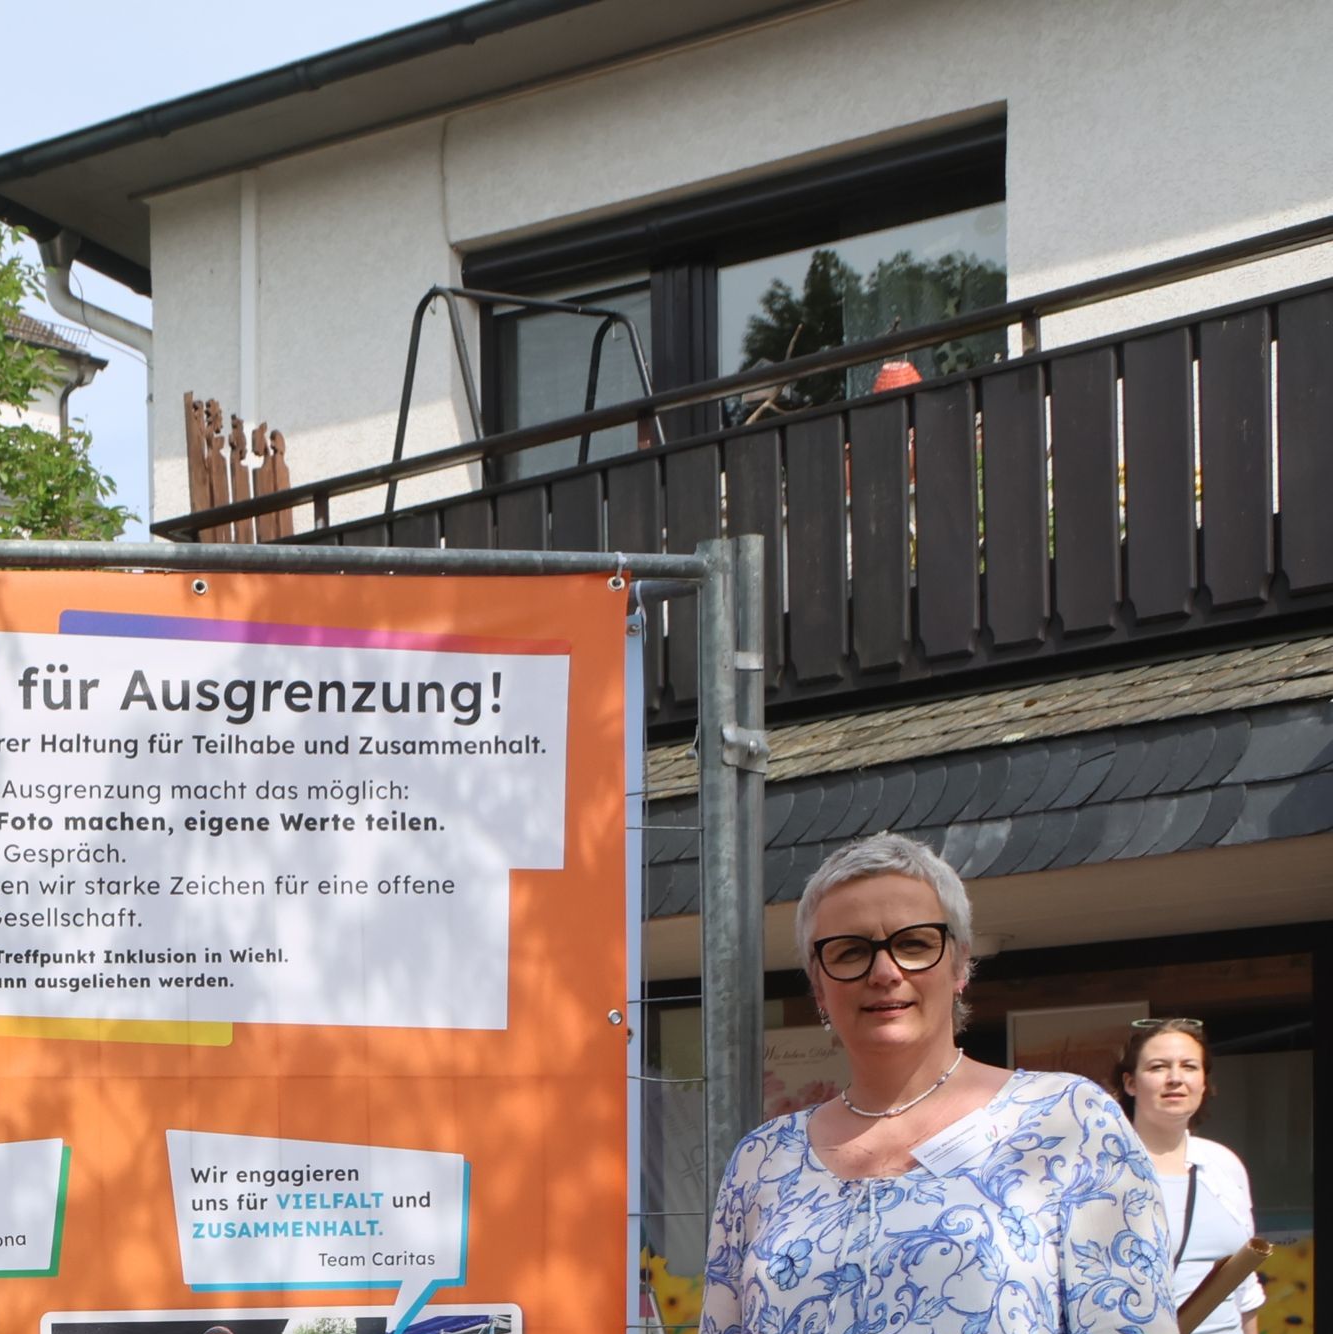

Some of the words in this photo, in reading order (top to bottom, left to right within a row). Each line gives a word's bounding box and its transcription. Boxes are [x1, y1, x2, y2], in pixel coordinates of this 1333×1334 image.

[18, 664, 100, 710] für
[120, 670, 501, 726] Ausgrenzung!
[41, 733, 138, 759] Haltung
[147, 733, 183, 754] für
[192, 733, 295, 754] Teilhabe
[304, 735, 349, 755] und
[359, 735, 546, 755] Zusammenhalt.
[1, 780, 161, 805] Ausgrenzung
[171, 780, 247, 800] macht
[255, 780, 298, 800] das
[308, 780, 408, 805] möglich:
[64, 811, 174, 836] machen,
[184, 810, 270, 837] eigene
[280, 813, 355, 831] Werte
[365, 810, 444, 831] teilen.
[4, 842, 126, 868] Gespräch.
[39, 874, 76, 895] wir
[85, 875, 160, 895] starke
[170, 875, 264, 895] Zeichen
[274, 874, 309, 895] für
[318, 875, 368, 895] eine
[377, 875, 455, 894] offene
[104, 948, 196, 964] Inklusion
[205, 947, 222, 963] in
[229, 947, 288, 963] Wiehl.
[34, 972, 150, 992] ausgeliehen
[158, 973, 234, 988] werden.
[190, 1165, 228, 1184] Wir
[236, 1164, 359, 1187] engagieren
[192, 1198, 228, 1211] uns
[237, 1192, 268, 1211] für
[276, 1192, 384, 1209] VIELFALT
[393, 1191, 430, 1208] und
[192, 1219, 383, 1239] ZUSAMMENHALT.
[318, 1253, 365, 1267] Team
[372, 1250, 435, 1266] Caritas
